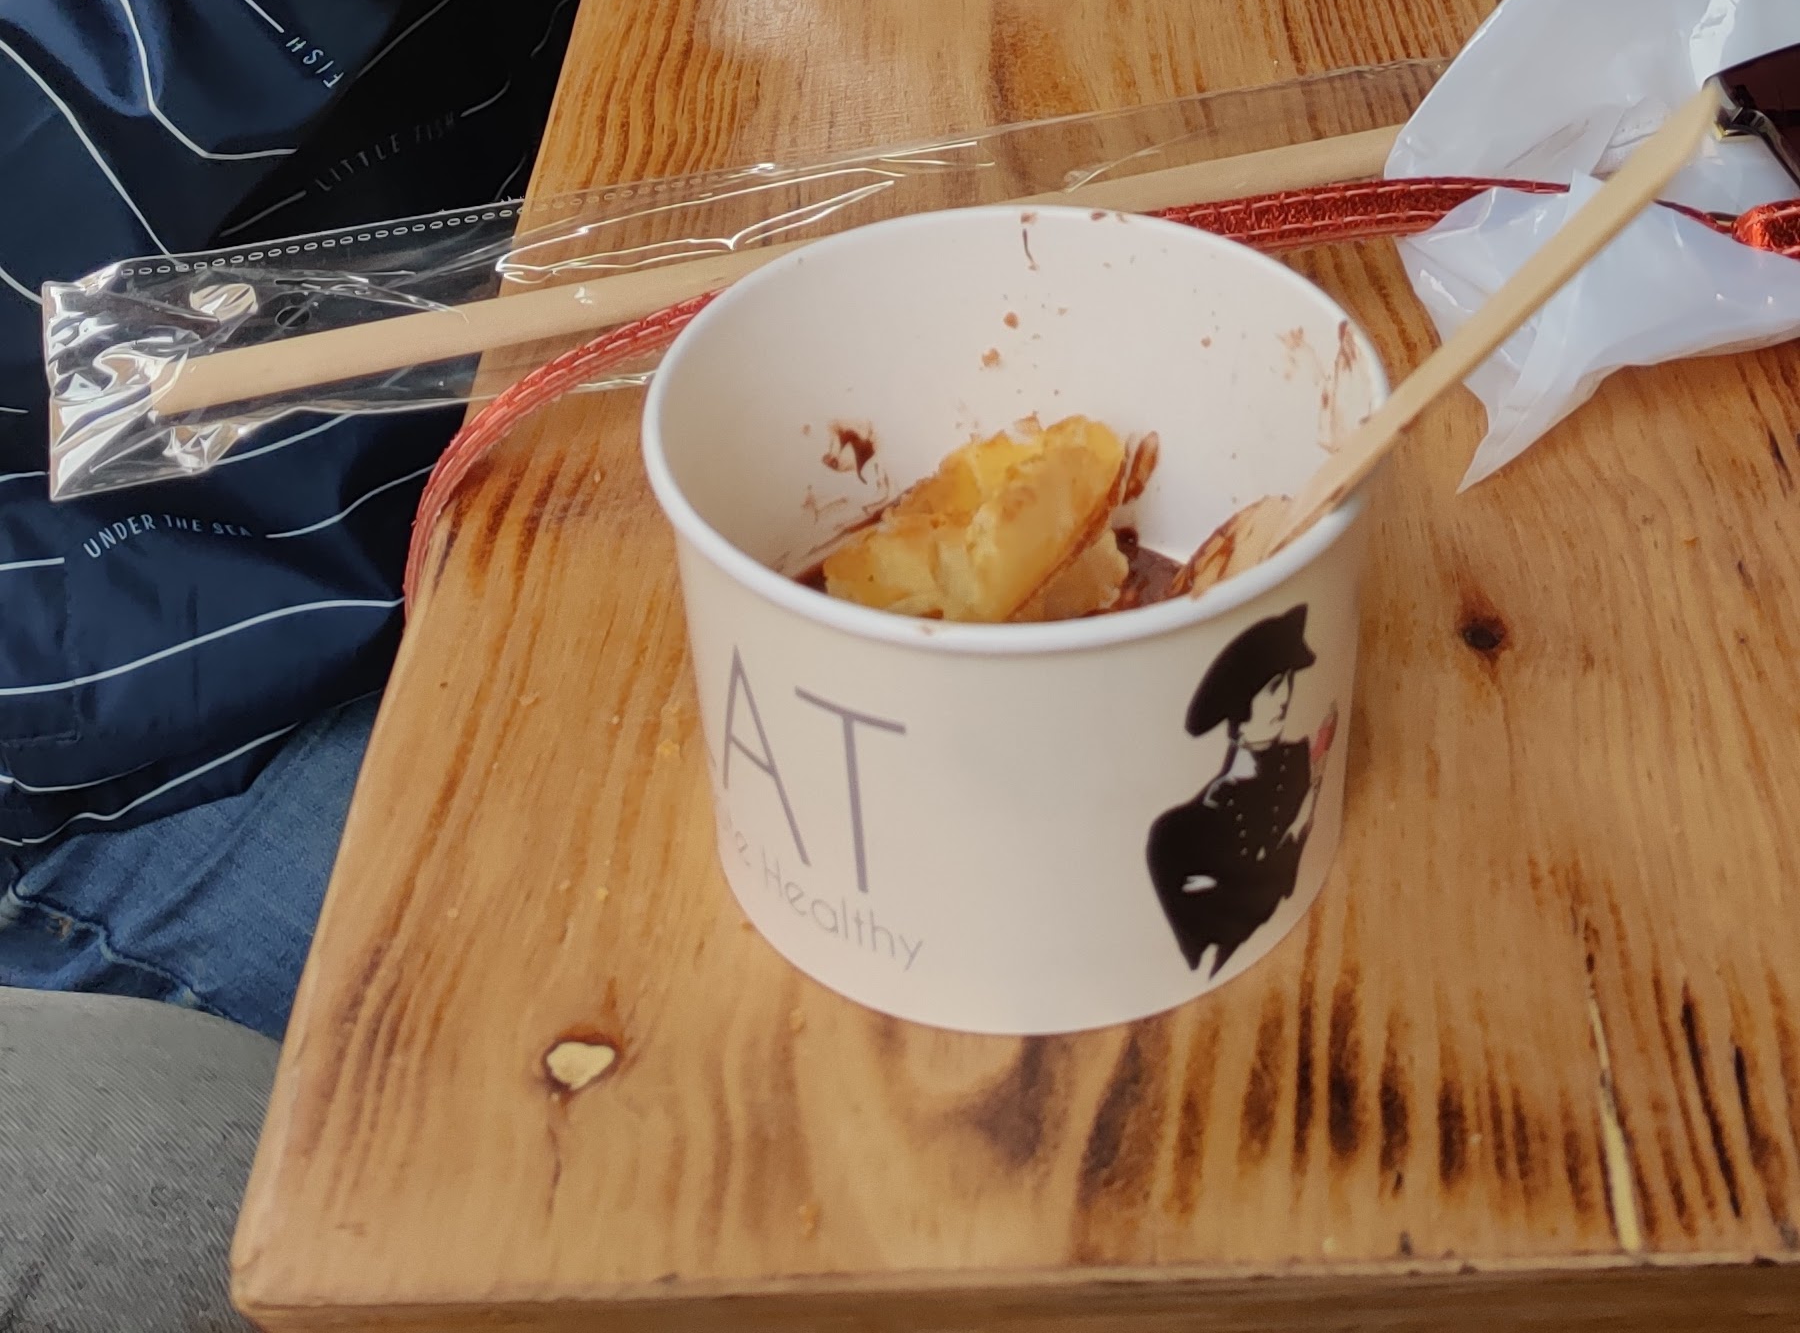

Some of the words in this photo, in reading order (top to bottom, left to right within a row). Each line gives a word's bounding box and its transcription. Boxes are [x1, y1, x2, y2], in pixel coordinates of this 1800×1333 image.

[285, 35, 345, 90] FISH
[312, 132, 402, 192] LITTLE
[82, 513, 157, 559] UNDER
[162, 514, 203, 533] THE
[761, 844, 924, 972] Healthy
